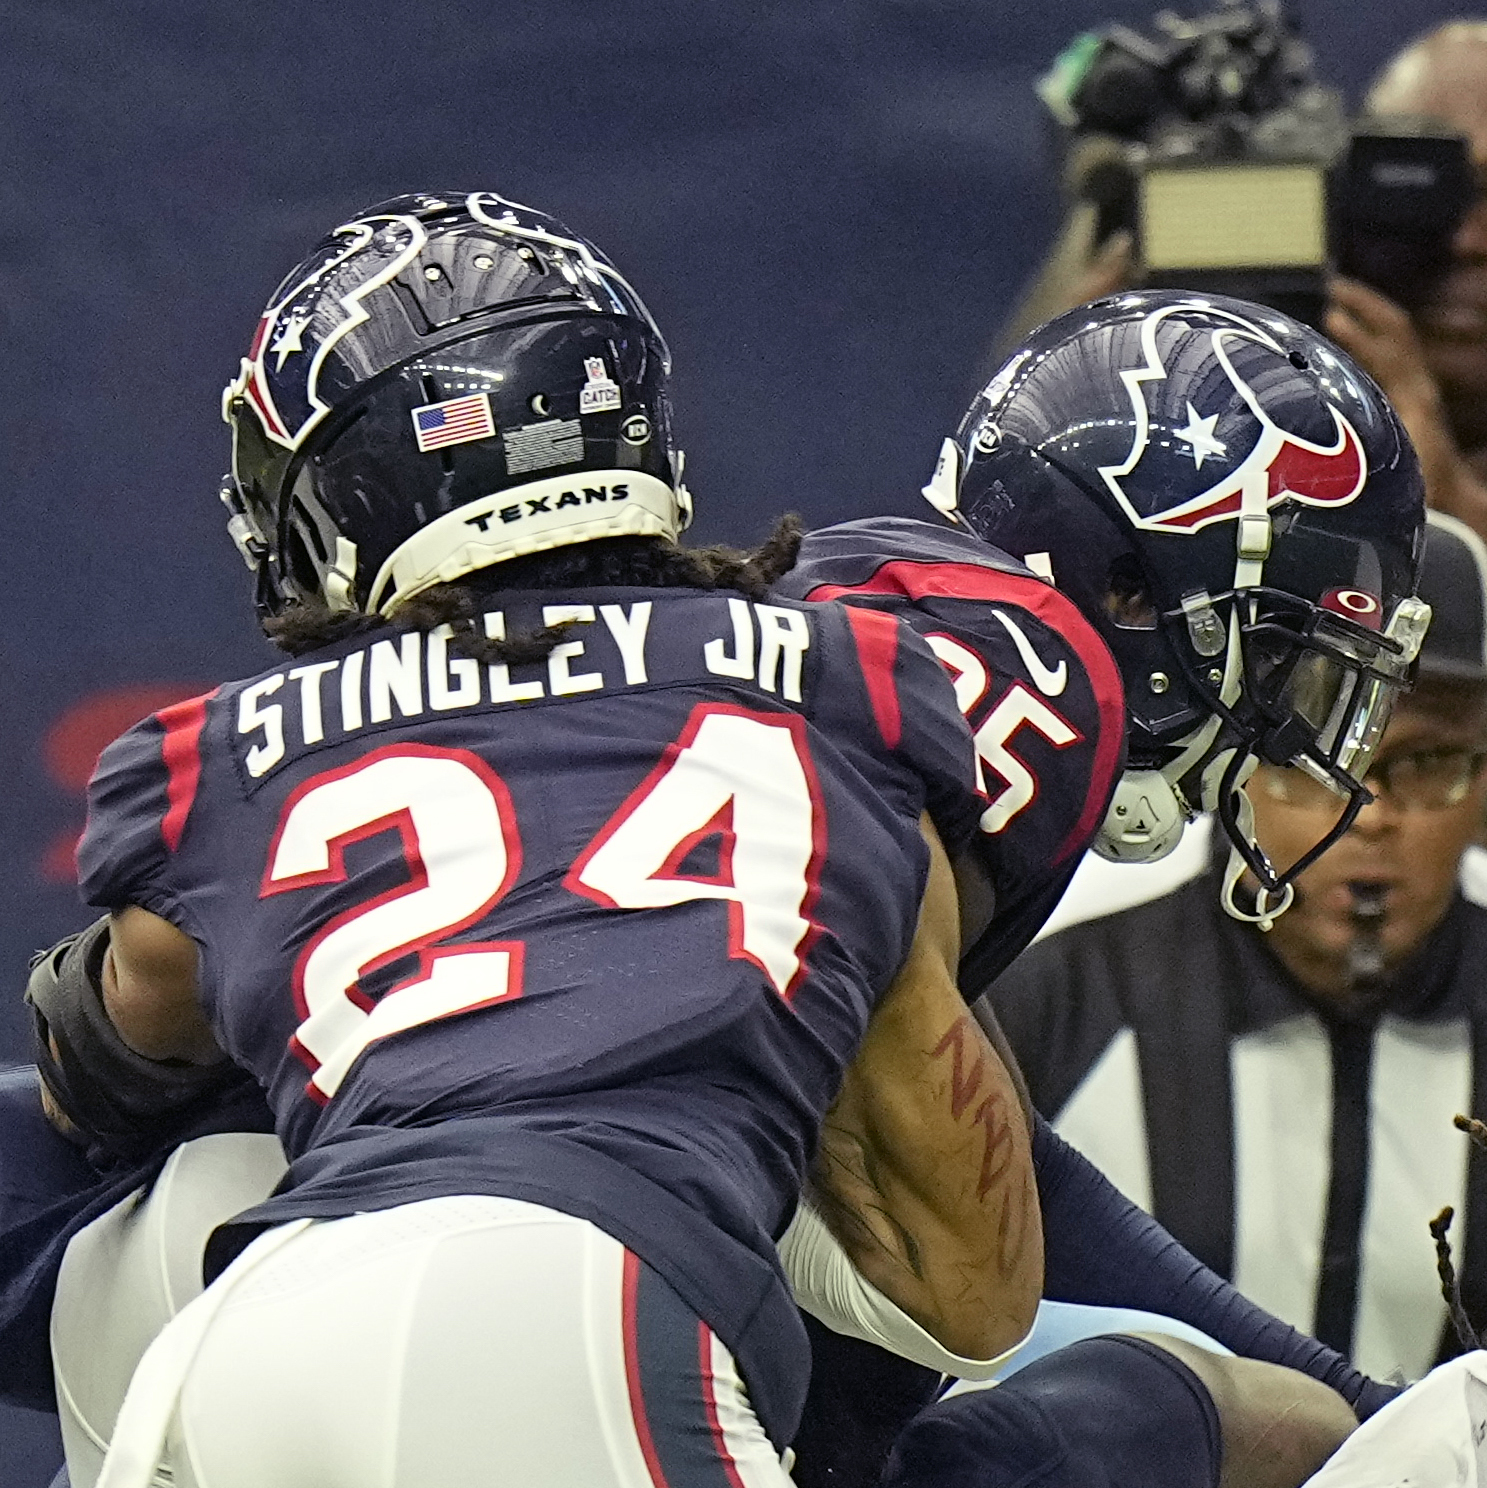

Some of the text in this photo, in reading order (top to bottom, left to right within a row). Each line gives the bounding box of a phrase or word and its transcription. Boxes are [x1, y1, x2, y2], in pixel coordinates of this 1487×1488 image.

[464, 484, 629, 533] TEXANS
[237, 597, 813, 779] STINGLEY JR
[261, 705, 830, 1105] 24
